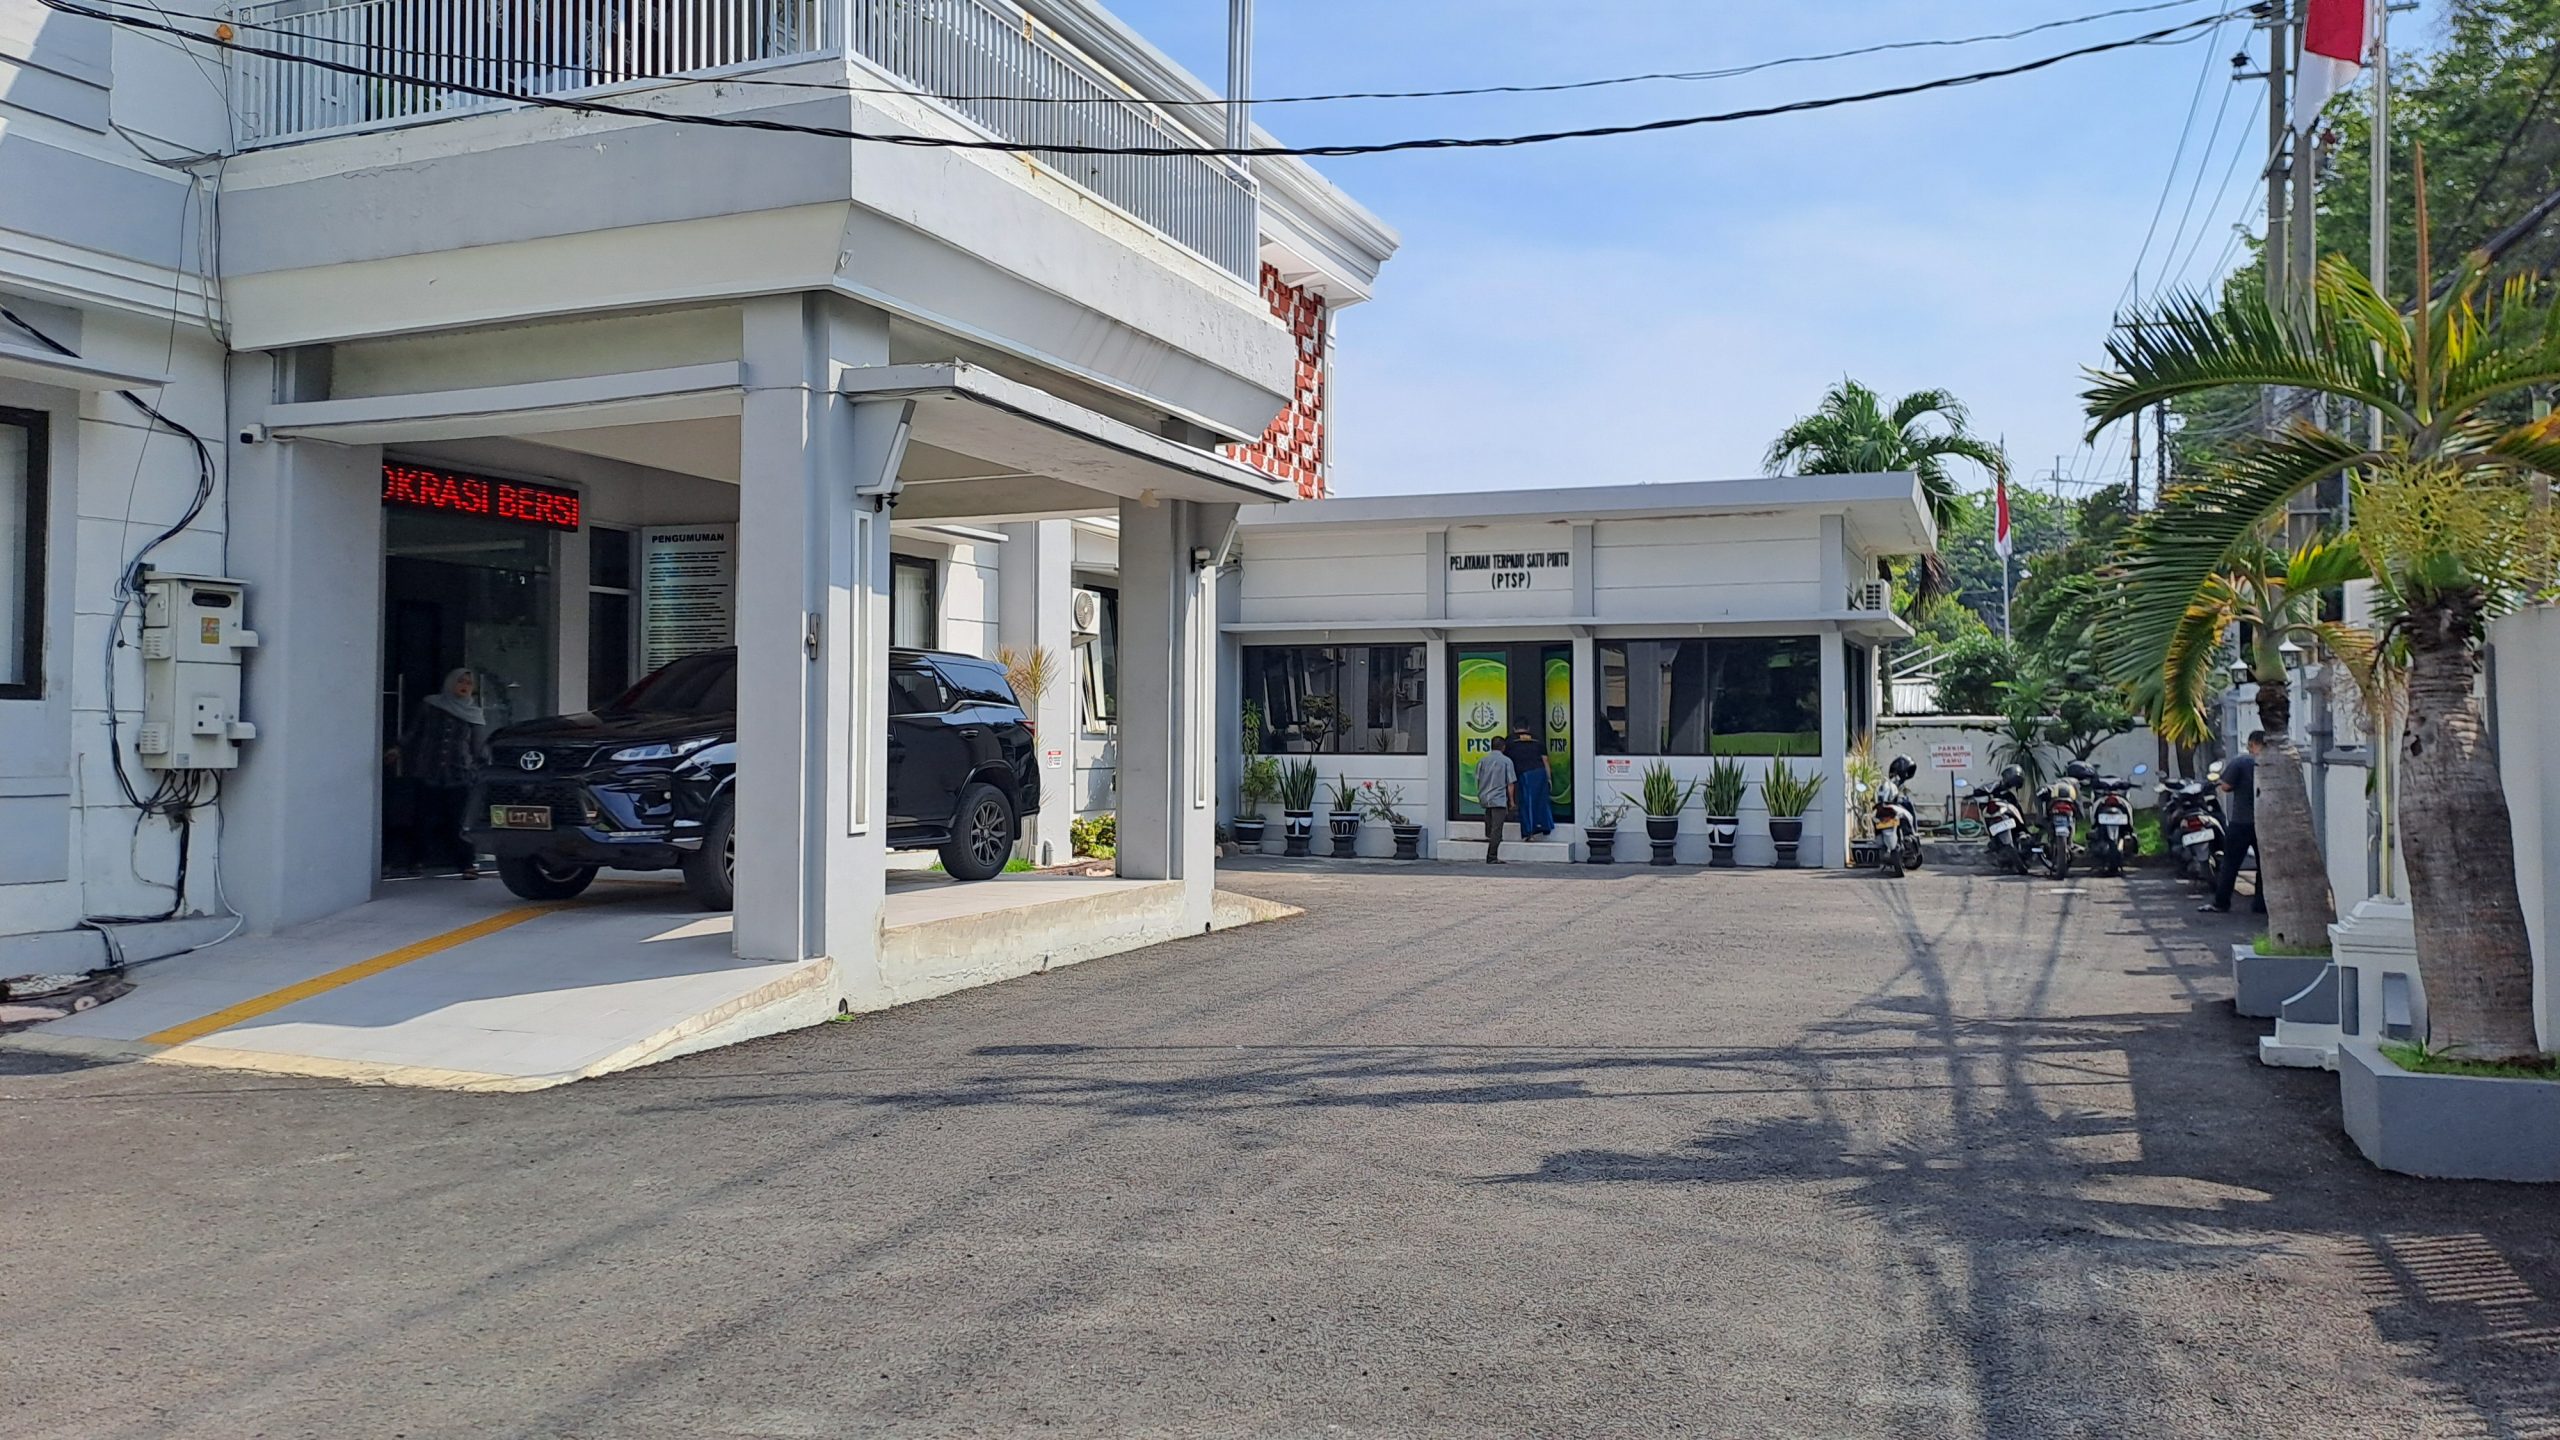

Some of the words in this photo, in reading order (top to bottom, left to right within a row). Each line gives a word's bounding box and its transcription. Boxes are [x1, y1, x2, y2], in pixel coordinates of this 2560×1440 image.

[498, 484, 579, 526] BERSI
[651, 532, 725, 544] PENGUMUMAN
[1450, 555, 1490, 571] PELAYANAN
[1492, 553, 1524, 569] TERPADU
[1527, 552, 1544, 568] SATU
[1546, 551, 1569, 568] PINTU
[1491, 571, 1531, 590] (PTSP)
[1467, 738, 1492, 752] PTS
[1550, 738, 1567, 752] PTSP
